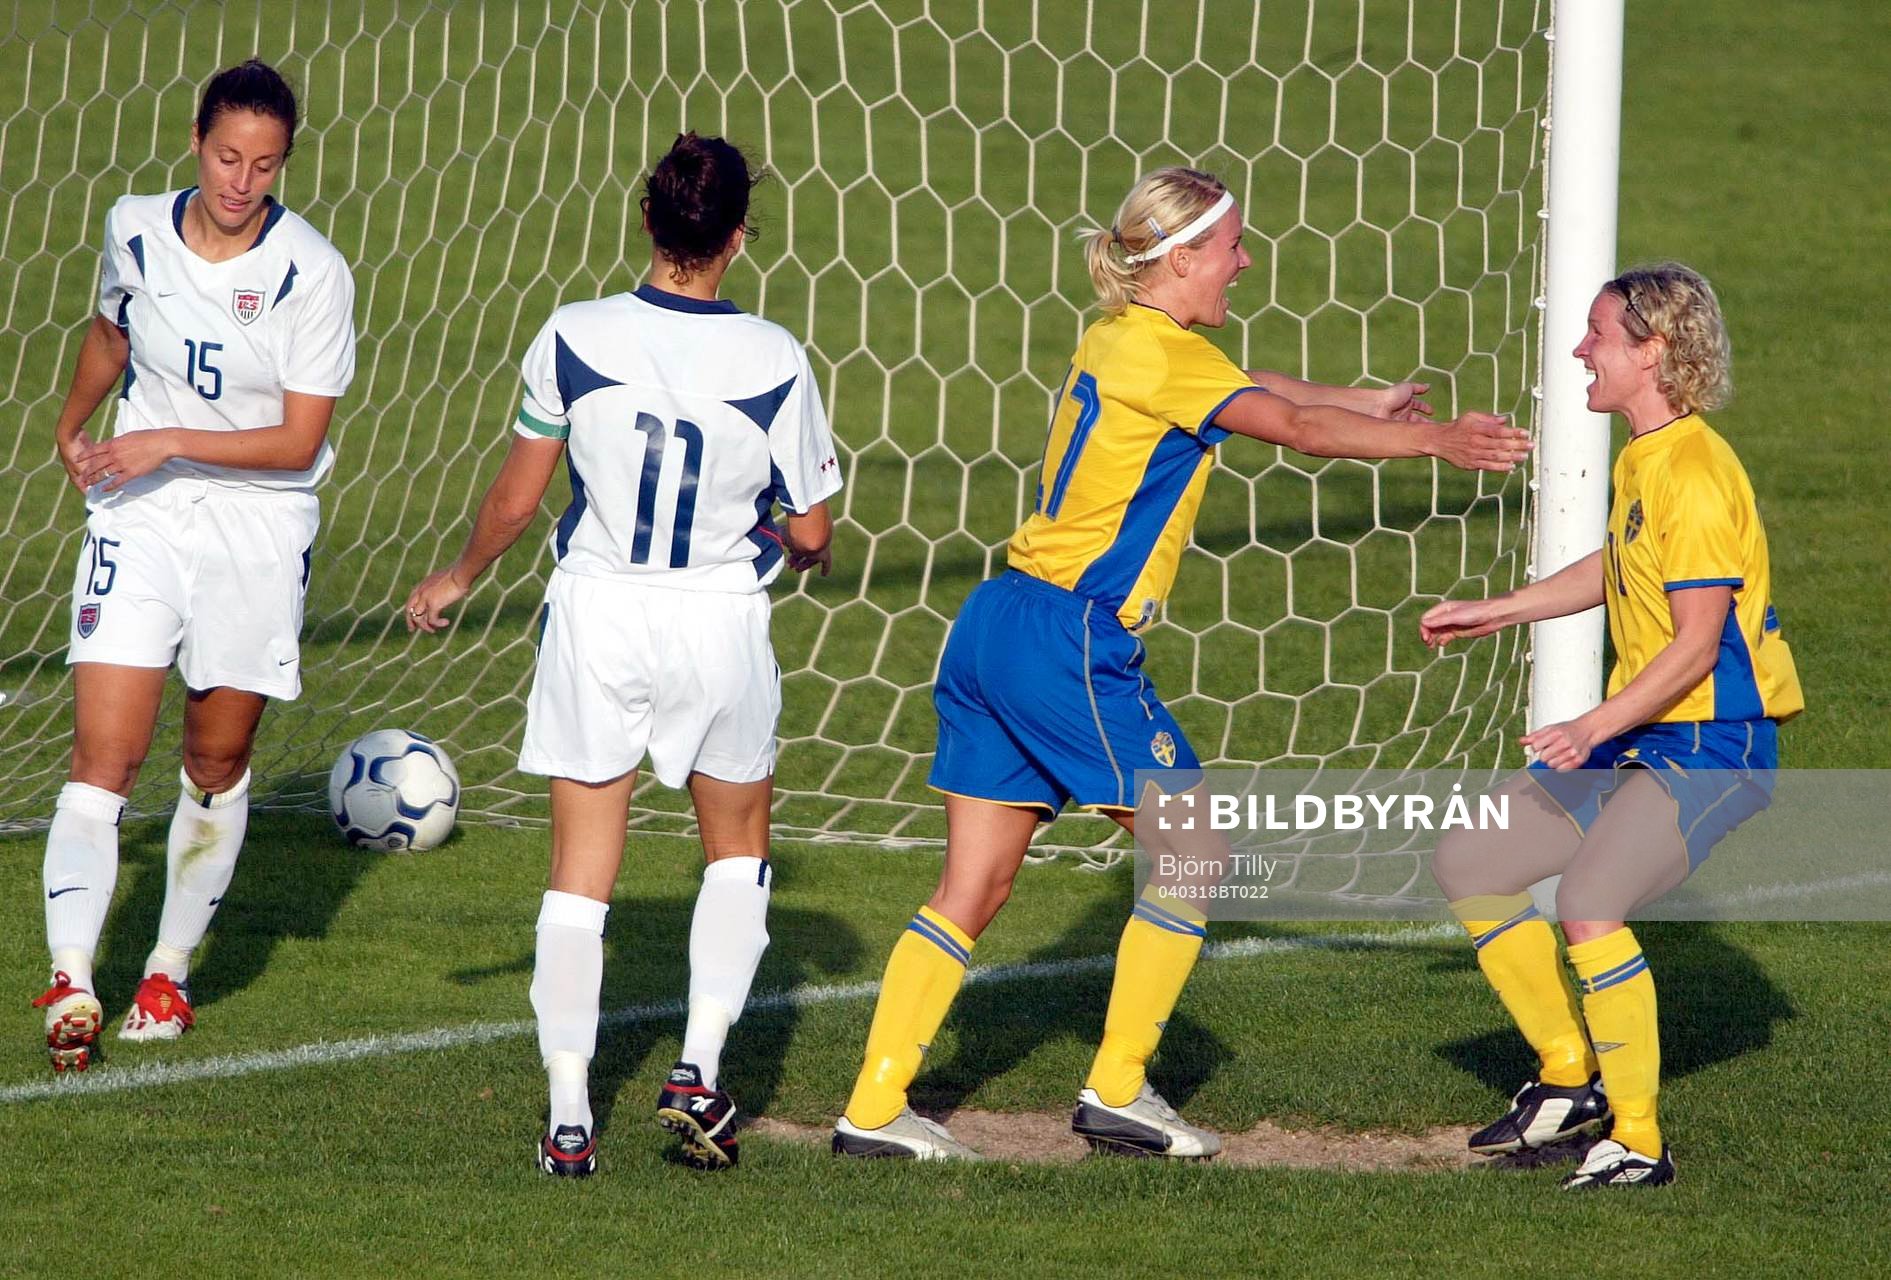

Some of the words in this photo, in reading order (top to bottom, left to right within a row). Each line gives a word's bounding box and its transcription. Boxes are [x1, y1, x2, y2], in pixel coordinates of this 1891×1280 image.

[184, 338, 224, 401] 15
[630, 410, 705, 569] 11
[86, 536, 121, 596] 15
